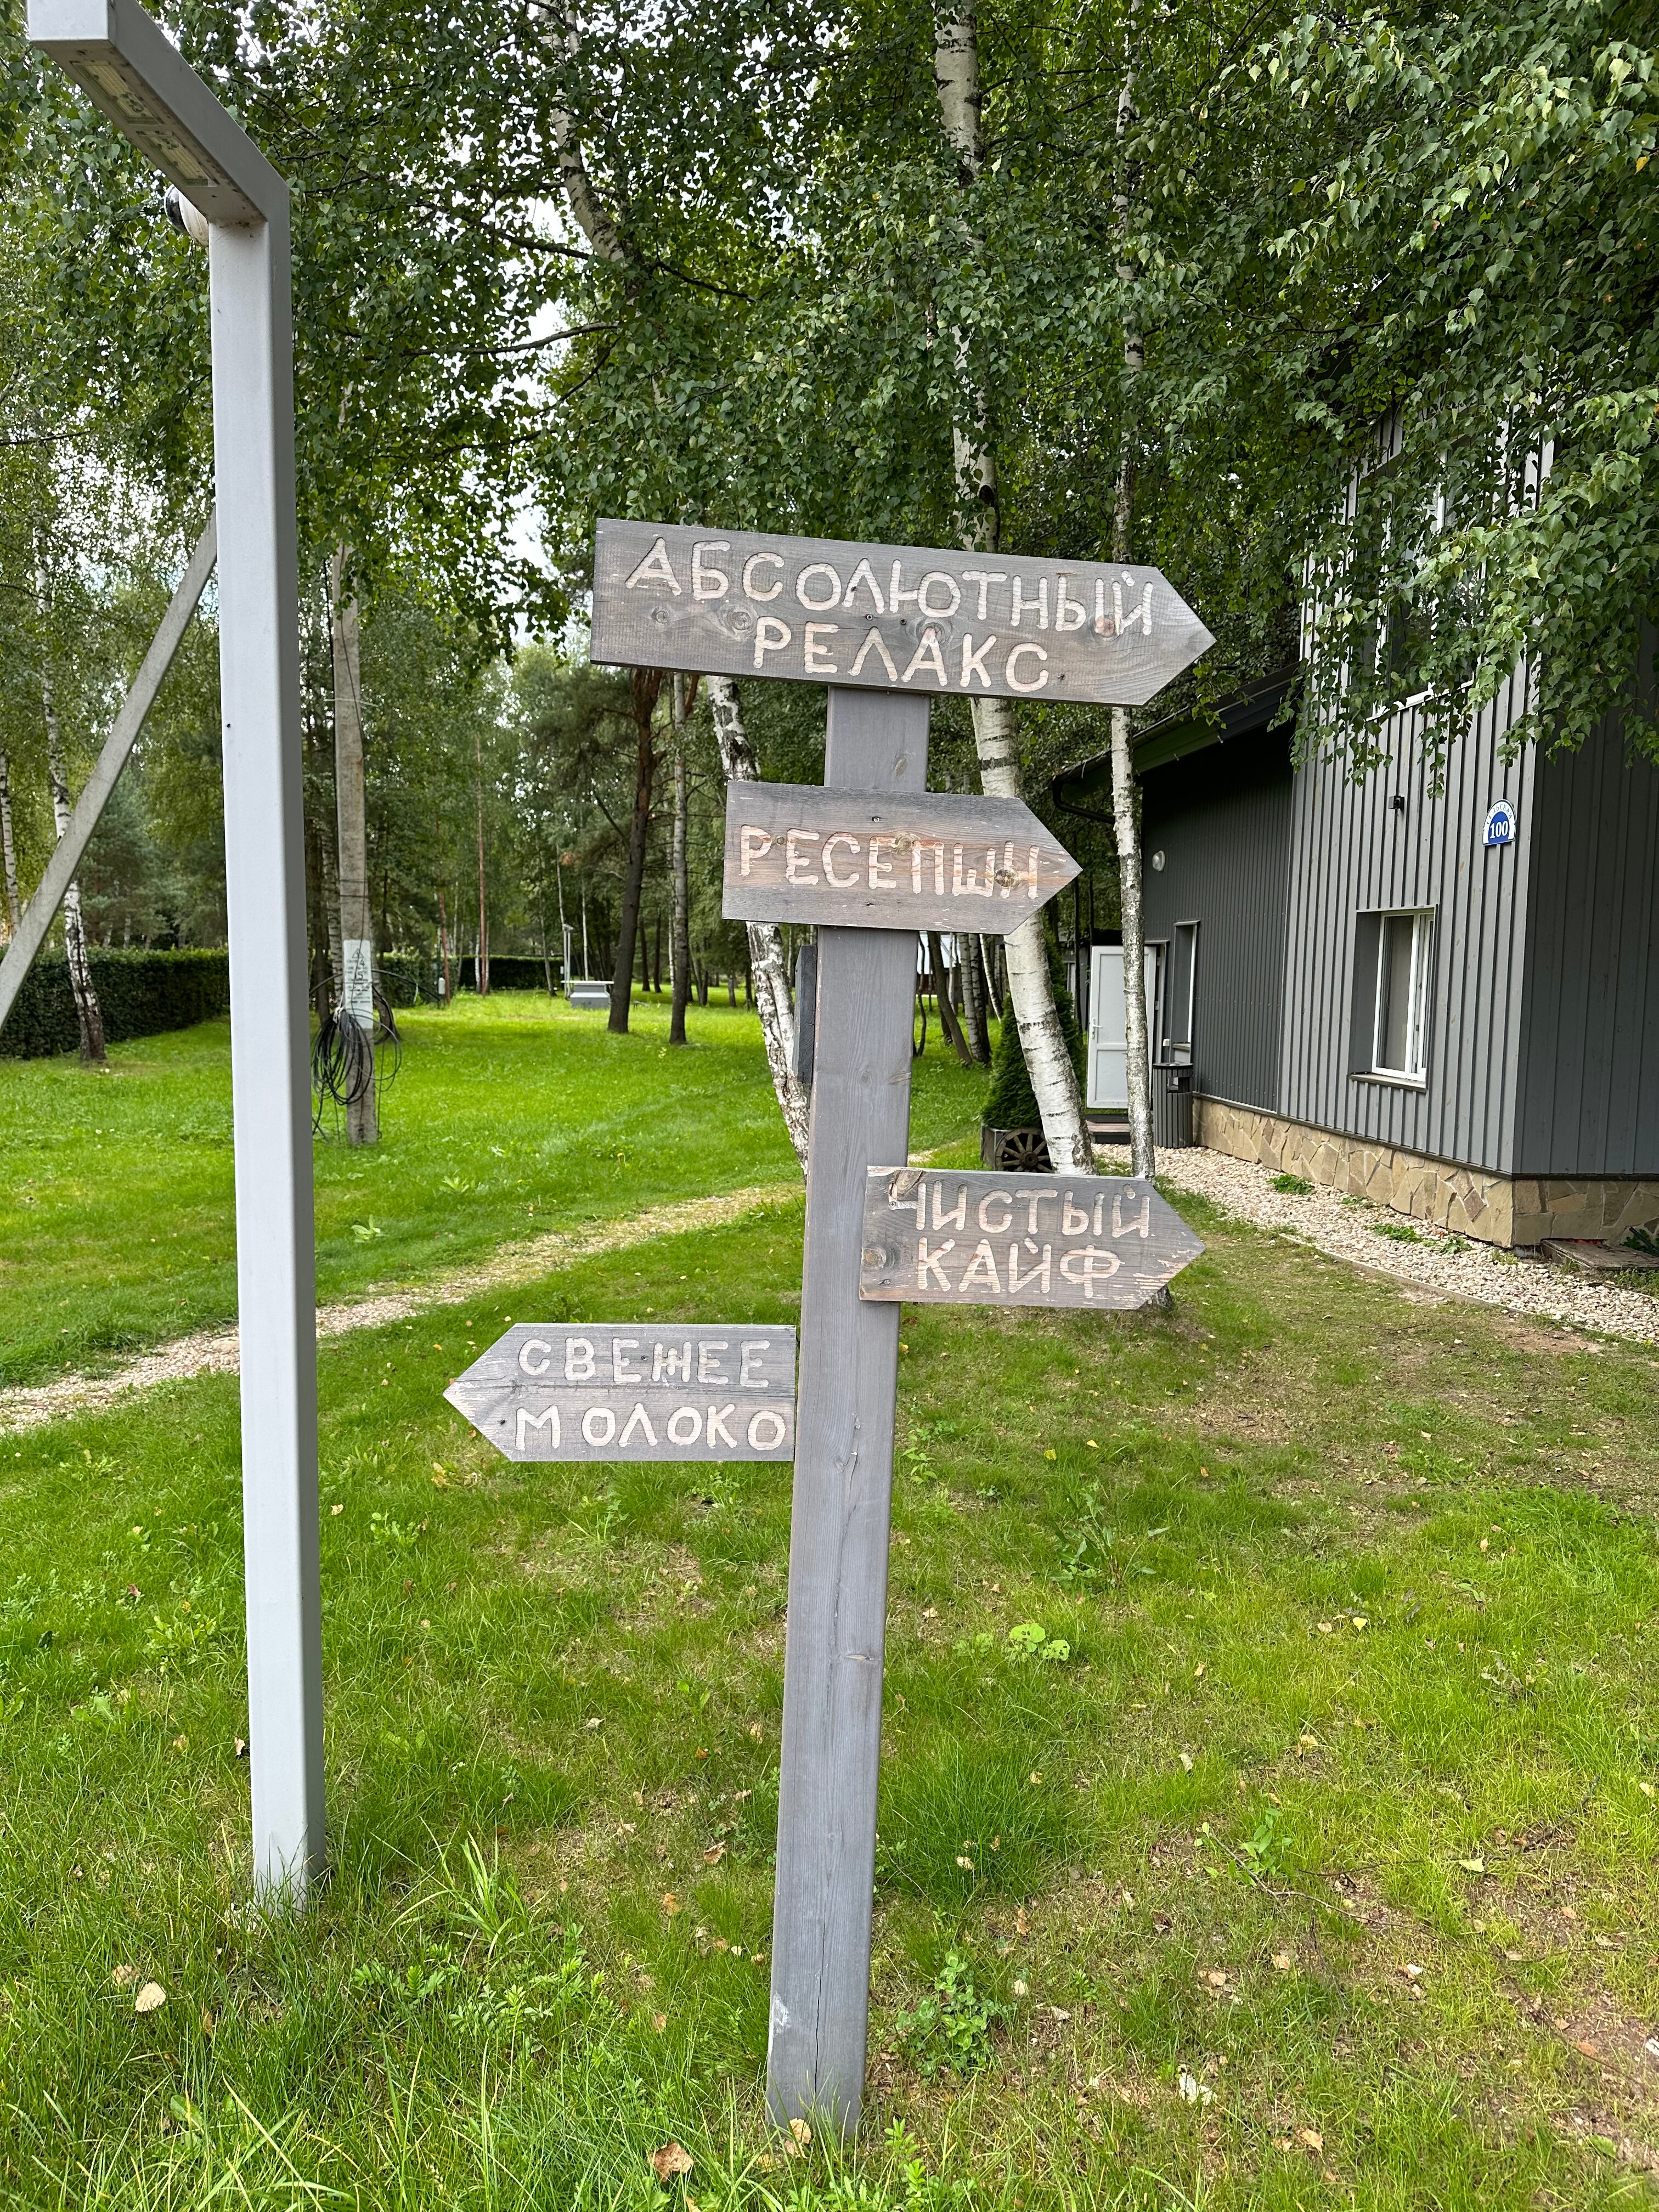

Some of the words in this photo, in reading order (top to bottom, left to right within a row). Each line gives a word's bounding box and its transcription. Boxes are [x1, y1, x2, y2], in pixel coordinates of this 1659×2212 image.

[625, 537, 1154, 636] АБСОЛЮТНЫЙ
[753, 616, 1048, 692] РЕЛАКС
[1489, 821, 1508, 839] 100
[739, 824, 1039, 899] РЕСЕПШН
[889, 1181, 1150, 1238] ЧИСТЫЙ
[917, 1237, 1120, 1299] КАЙФ
[518, 1337, 770, 1388] СВЕЖЕЕ
[515, 1402, 787, 1451] МОЛОКО
